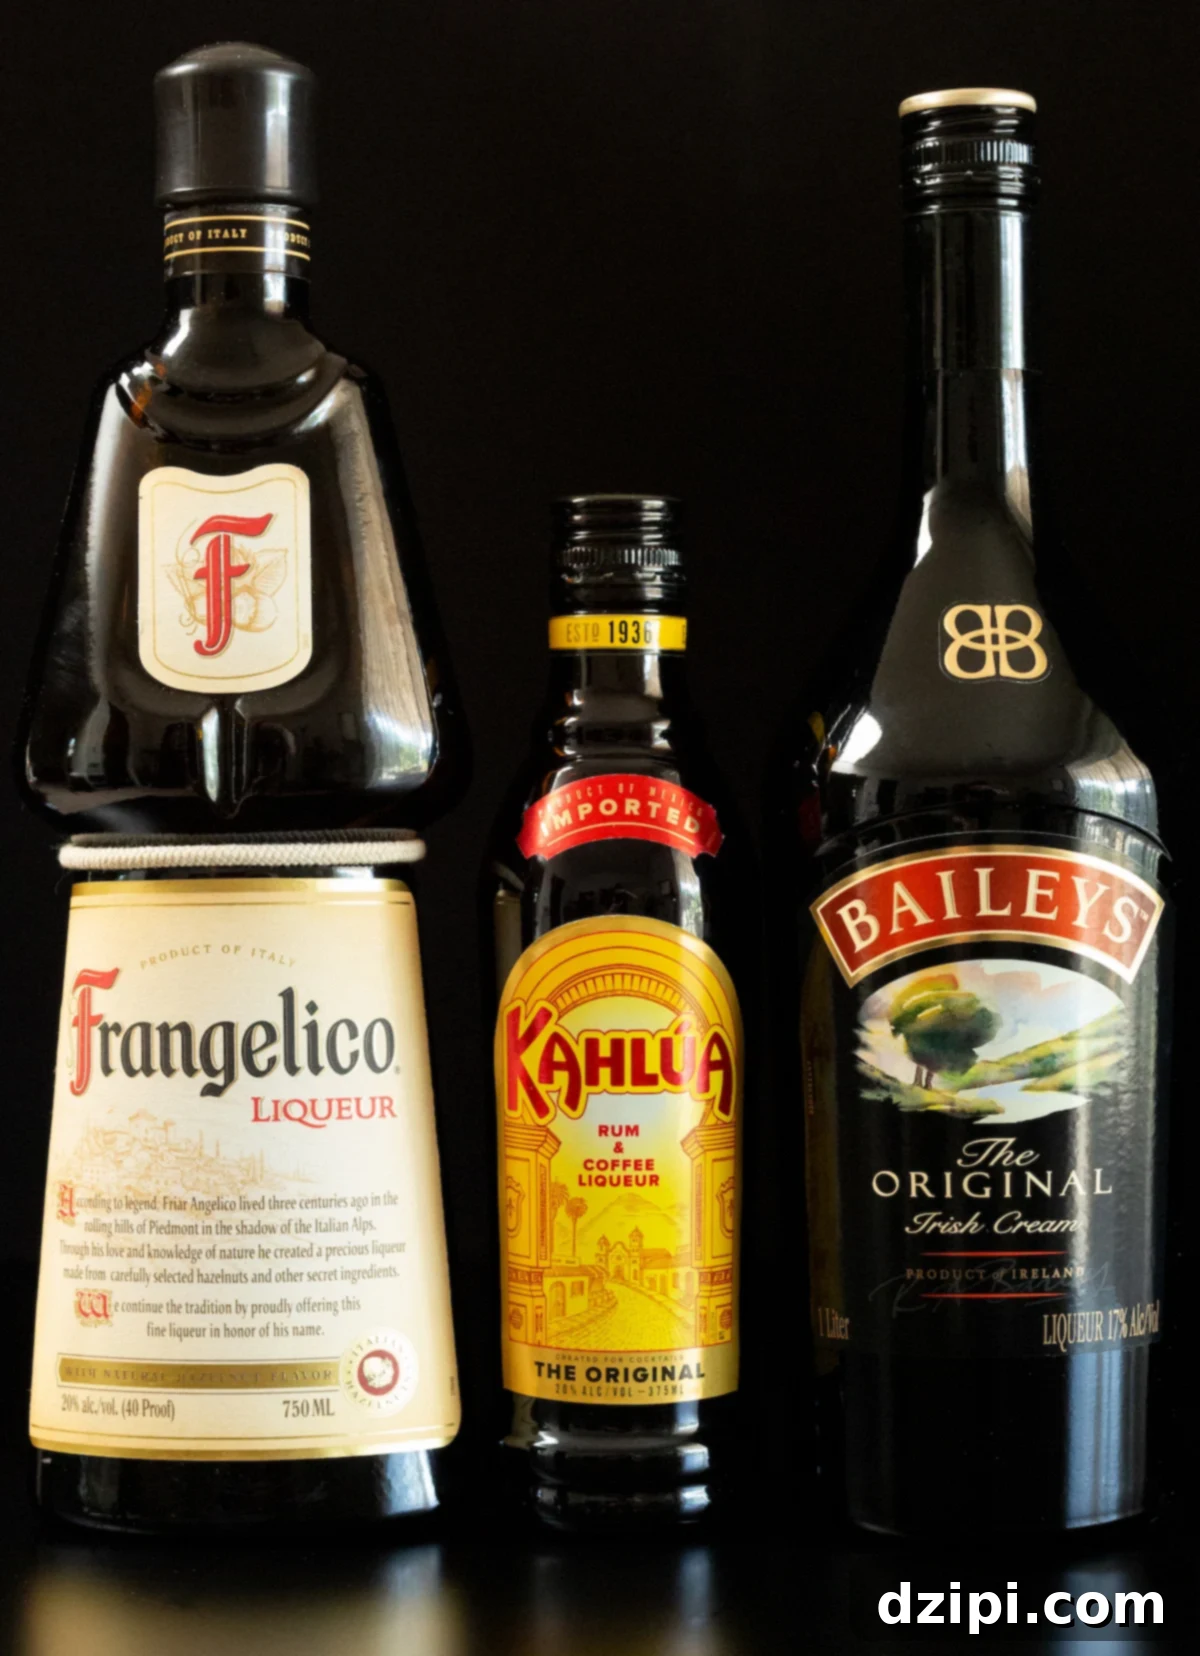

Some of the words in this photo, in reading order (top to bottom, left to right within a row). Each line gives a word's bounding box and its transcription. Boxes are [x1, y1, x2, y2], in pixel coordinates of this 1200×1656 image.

[188, 230, 202, 241] OF
[207, 228, 248, 240] ITALY
[608, 620, 653, 644] 1936
[618, 783, 635, 794] OF
[540, 798, 701, 837] IMPORTED
[836, 867, 1141, 954] BAILEYS
[140, 944, 212, 970] PRODUCT
[221, 943, 242, 956] OF
[250, 946, 296, 968] ITALY
[69, 967, 396, 1097] Frangelico
[506, 1005, 734, 1120] KAHLÚA
[251, 1096, 397, 1129] LIQUEUR
[598, 1124, 640, 1137] RUM
[613, 1142, 625, 1154] &
[957, 1137, 1040, 1167] The
[583, 1158, 655, 1171] COFFEE
[577, 1174, 661, 1187] LIQUEUR
[872, 1168, 1113, 1199] ORIGINAL
[114, 1197, 123, 1210] to
[163, 1196, 188, 1211] Friar
[191, 1195, 237, 1215] Angelico
[239, 1195, 265, 1210] lived
[268, 1194, 296, 1210] three
[299, 1194, 348, 1210] centuries
[350, 1198, 369, 1212] ago
[371, 1192, 381, 1207] in
[383, 1190, 398, 1206] the
[84, 1218, 112, 1237] rolling
[114, 1218, 134, 1235] hills
[136, 1218, 148, 1235] of
[149, 1219, 198, 1236] Piedmont
[202, 1220, 213, 1236] in
[215, 1220, 231, 1236] the
[235, 1219, 277, 1236] shadow
[280, 1218, 293, 1235] of
[294, 1218, 312, 1234] the
[314, 1216, 349, 1234] Italian
[351, 1216, 376, 1235] Alps.
[905, 1211, 985, 1235] Irish
[992, 1210, 1082, 1235] Cream
[92, 1240, 104, 1257] his
[107, 1242, 125, 1258] love
[127, 1242, 145, 1259] and
[147, 1243, 203, 1263] knowledge
[206, 1244, 219, 1261] of
[220, 1246, 255, 1261] nature
[258, 1244, 272, 1260] he
[274, 1243, 313, 1259] created
[316, 1247, 323, 1257] a
[325, 1241, 369, 1262] precious
[371, 1239, 407, 1259] liqueur
[110, 1267, 150, 1288] carefully
[153, 1268, 194, 1284] selected
[197, 1268, 249, 1285] hazelnuts
[251, 1267, 272, 1284] and
[275, 1267, 304, 1283] other
[306, 1267, 338, 1282] secret
[340, 1264, 400, 1285] ingredients.
[905, 1268, 986, 1281] PRODUCT
[1012, 1266, 1084, 1280] IRELAND
[120, 1298, 163, 1313] continue
[165, 1299, 183, 1314] the
[185, 1299, 232, 1315] tradition
[235, 1299, 247, 1318] by
[250, 1298, 291, 1318] proudly
[295, 1297, 339, 1316] offering
[341, 1296, 361, 1311] this
[147, 1321, 167, 1338] fine
[169, 1322, 206, 1343] liqueur
[209, 1323, 221, 1338] in
[223, 1322, 256, 1339] honor
[258, 1321, 270, 1338] of
[273, 1322, 290, 1337] his
[292, 1324, 325, 1337] name.
[825, 1307, 850, 1340] Liter
[1043, 1311, 1104, 1352] LIQUEUR
[1108, 1306, 1128, 1341] 17%
[555, 1354, 599, 1363] CREATED
[604, 1355, 623, 1364] FOR
[271, 1369, 333, 1382] FLAVOR
[534, 1361, 577, 1382] THE
[585, 1363, 706, 1384] ORIGINAL
[581, 1385, 632, 1398] ALC/VOL
[61, 1393, 80, 1412] 20%
[121, 1398, 139, 1420] (40
[141, 1398, 175, 1422] Proof)
